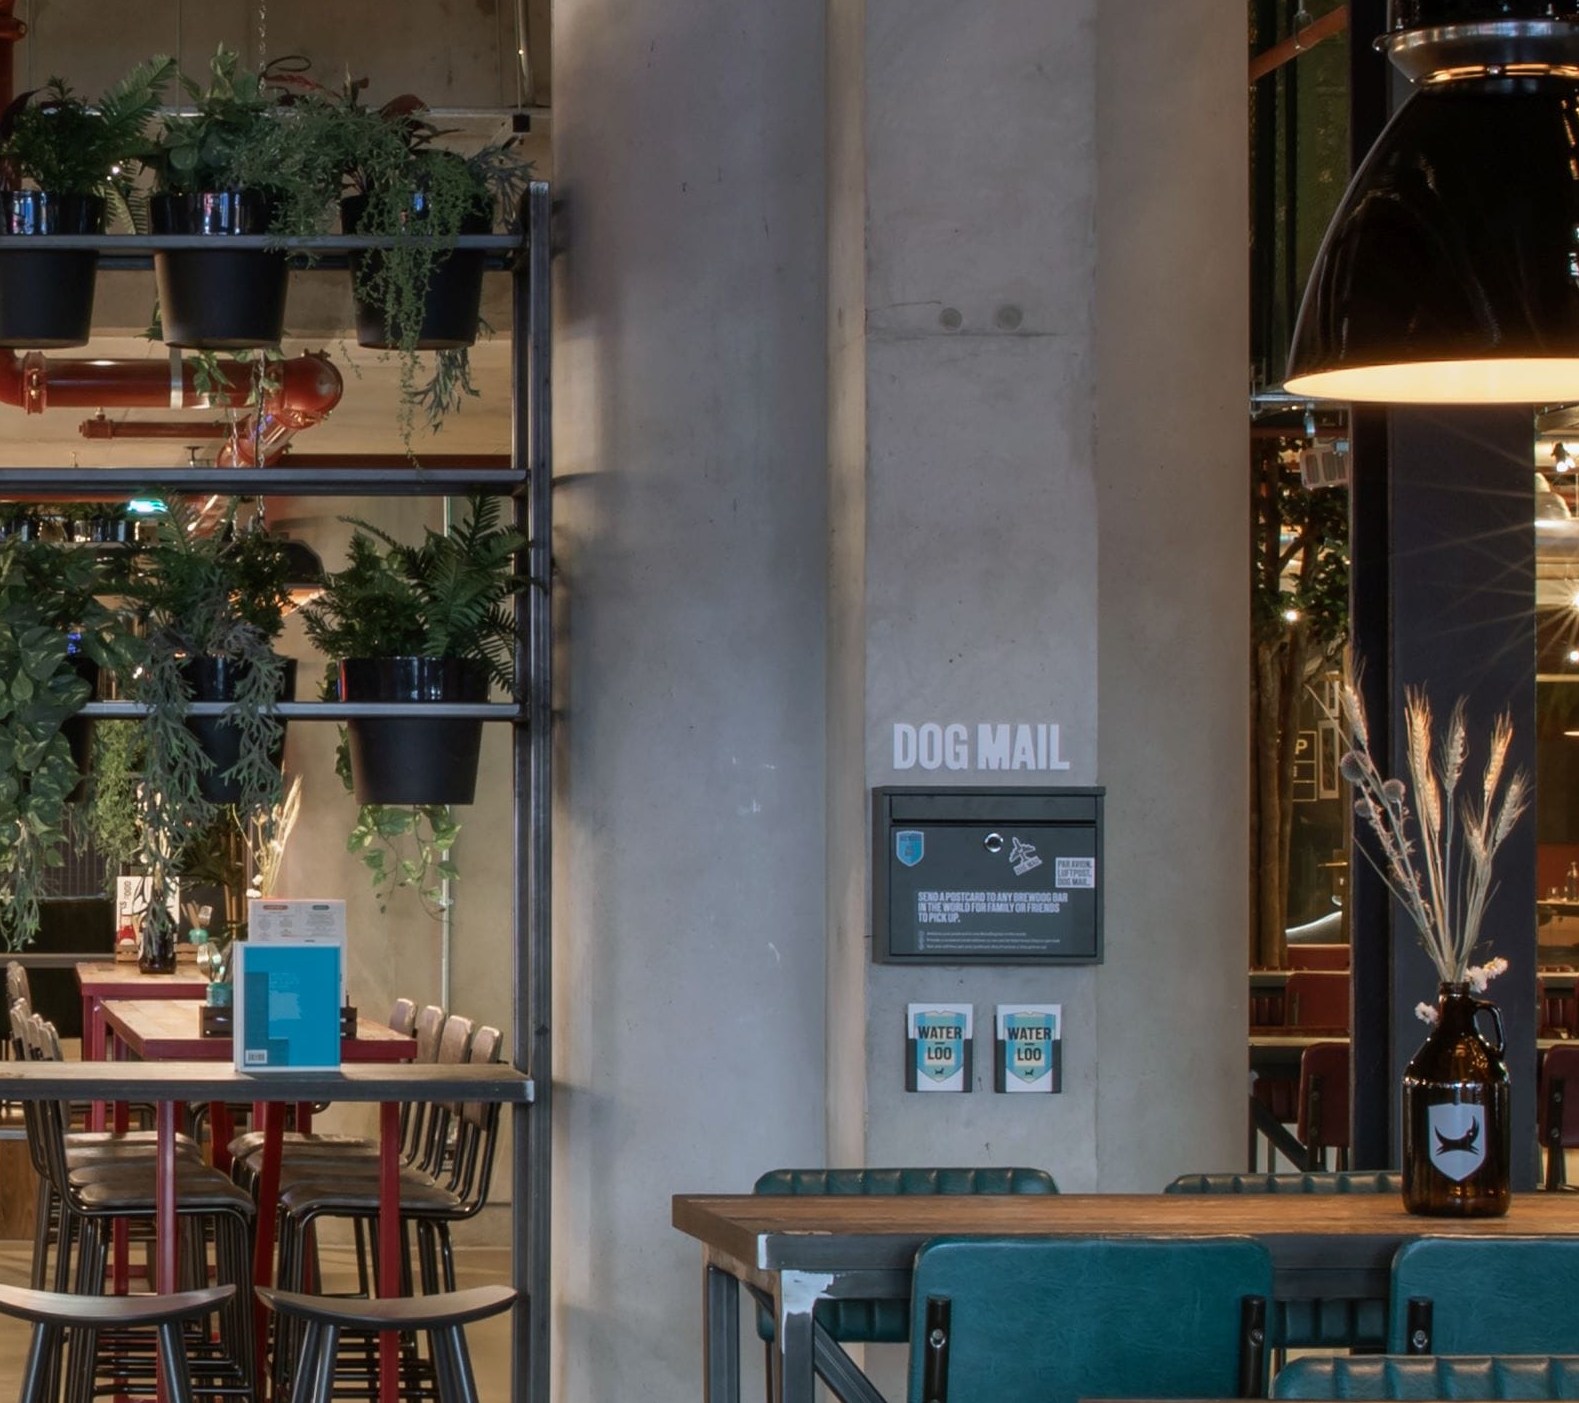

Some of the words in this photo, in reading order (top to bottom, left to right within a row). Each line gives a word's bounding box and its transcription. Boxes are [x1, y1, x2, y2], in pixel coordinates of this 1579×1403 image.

[894, 723, 968, 770] DOG
[977, 724, 1070, 770] MAIL
[918, 892, 938, 902] SEND
[939, 892, 945, 902] A
[946, 892, 985, 902] POSTCARD
[986, 892, 996, 902] TO
[997, 892, 1012, 902] ANY
[1013, 892, 1051, 902] BREWDOG
[1052, 892, 1068, 902] BAR
[918, 903, 926, 912] IN
[927, 903, 942, 912] THE
[943, 903, 970, 912] WORLD
[971, 903, 986, 912] FOR
[987, 903, 1015, 912] FAMILY
[1015, 903, 1026, 912] OR
[1027, 903, 1060, 912] FRIENDS
[918, 913, 928, 922] TO
[929, 913, 947, 922] PICK
[918, 1026, 962, 1039] WATER
[1007, 1027, 1052, 1040] WATER
[927, 1047, 952, 1060] LOO
[1017, 1048, 1042, 1061] LOO
